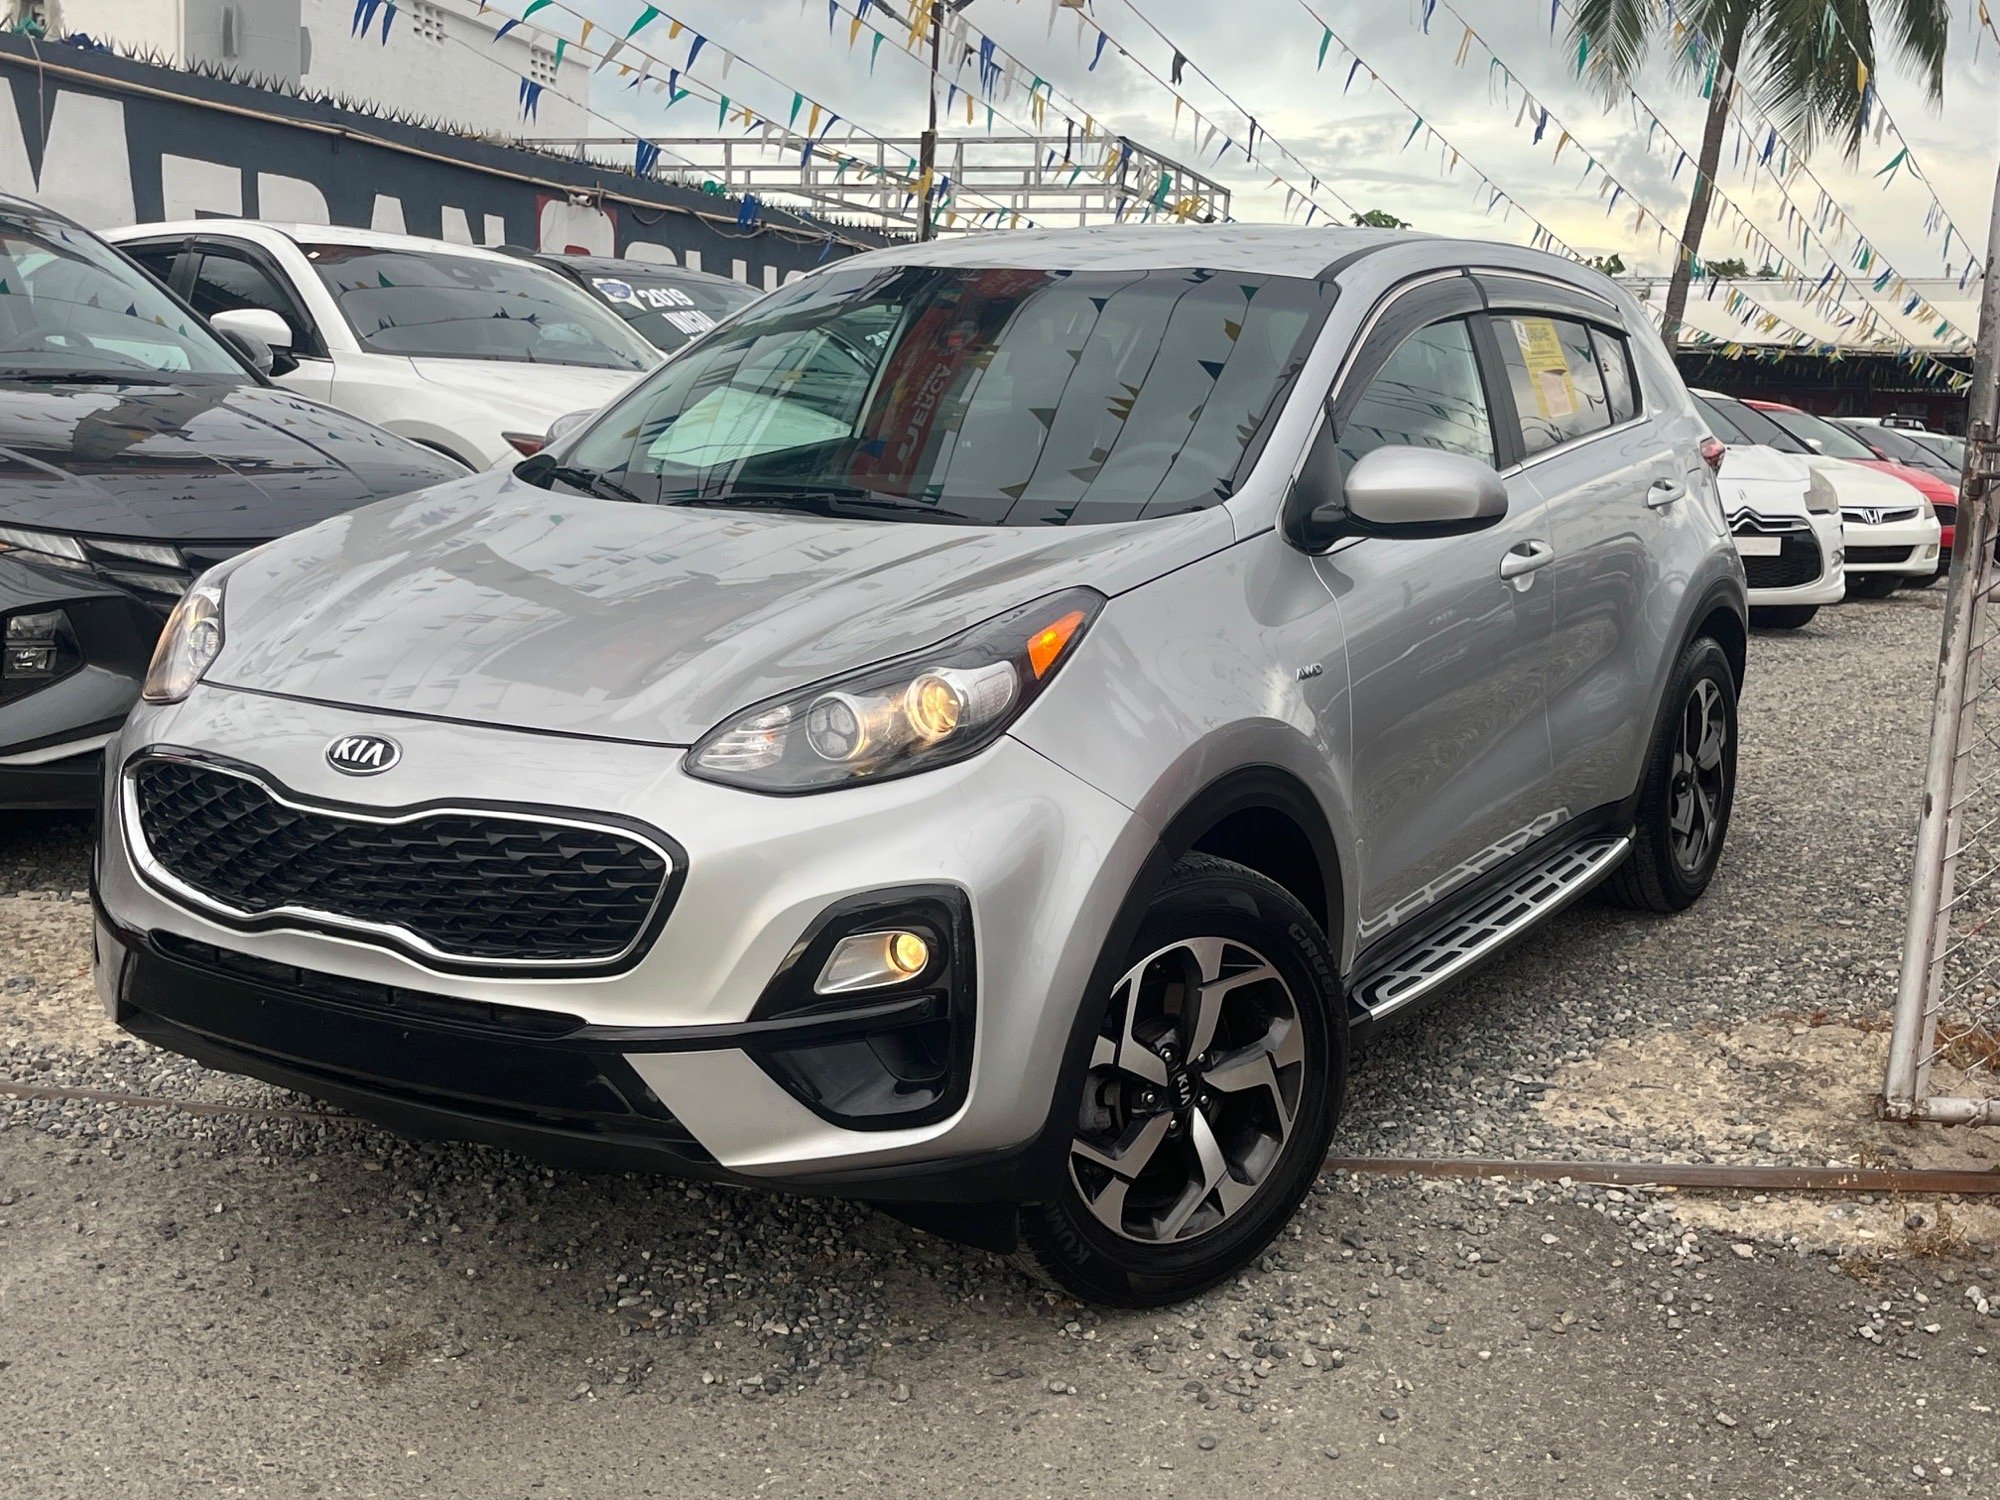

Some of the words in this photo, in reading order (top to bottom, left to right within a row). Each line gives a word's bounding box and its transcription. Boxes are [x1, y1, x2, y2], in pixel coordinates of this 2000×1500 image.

[636, 287, 695, 308] 2019
[333, 737, 385, 767] KIA
[1177, 1072, 1191, 1106] KIA
